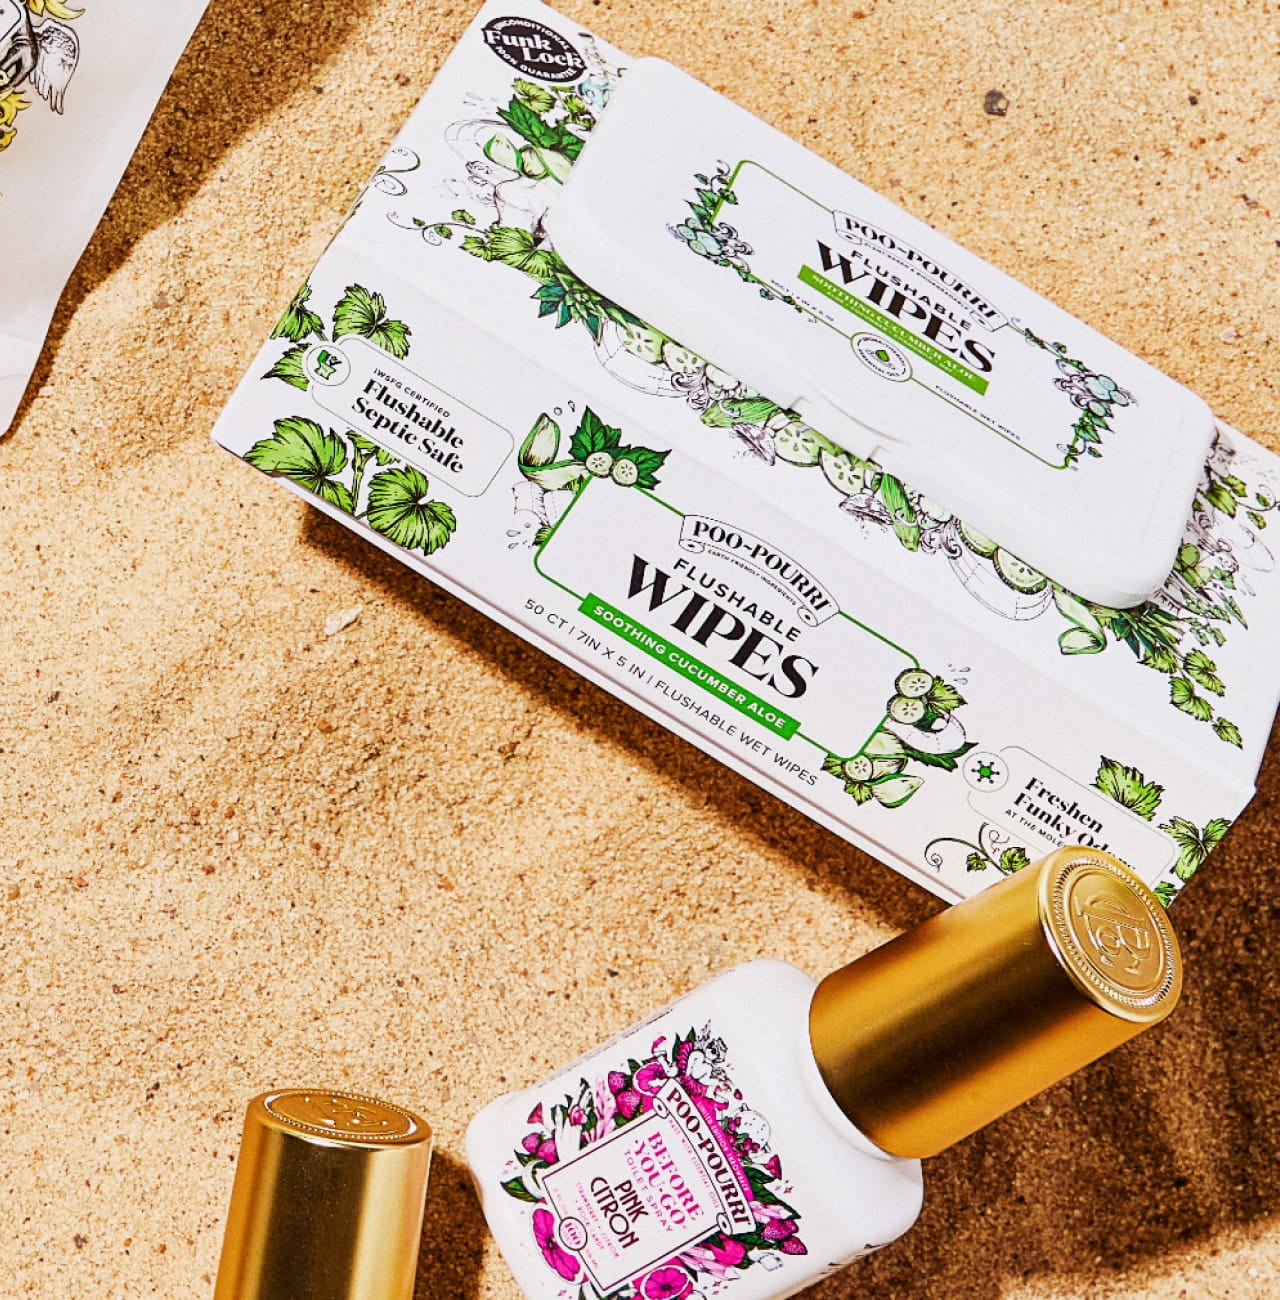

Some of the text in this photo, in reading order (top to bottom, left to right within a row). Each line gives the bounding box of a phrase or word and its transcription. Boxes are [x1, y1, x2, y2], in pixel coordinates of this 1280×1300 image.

[485, 30, 552, 51] Funk
[522, 46, 585, 68] Lock
[816, 240, 996, 373] WIPES
[850, 249, 973, 332] FLUSHABLE
[351, 397, 463, 473] Septic Safe
[362, 378, 464, 448] Flushable
[403, 386, 451, 418] CERTIFIED
[628, 553, 819, 698] WIPES
[673, 557, 802, 642] FLUSHABLE
[524, 598, 545, 615] 50
[546, 613, 568, 629] CT
[576, 630, 601, 651] 7IN
[601, 647, 615, 659] X
[616, 655, 628, 667] 5
[628, 663, 646, 679] IN
[655, 680, 738, 736] FLUSHABLE
[739, 732, 772, 757] WET
[773, 752, 818, 786] WIPES
[593, 605, 786, 729] SOOTHING CUCUMBER ALOE
[1005, 809, 1018, 819] AT
[1019, 817, 1037, 831] THE
[1014, 792, 1076, 839] Funky
[1025, 777, 1103, 833] Freshen
[590, 1176, 639, 1249] CITRON
[614, 1180, 649, 1224] PINK
[624, 1150, 673, 1231] TOILET SPRAY
[648, 1131, 705, 1220] BEFORE
